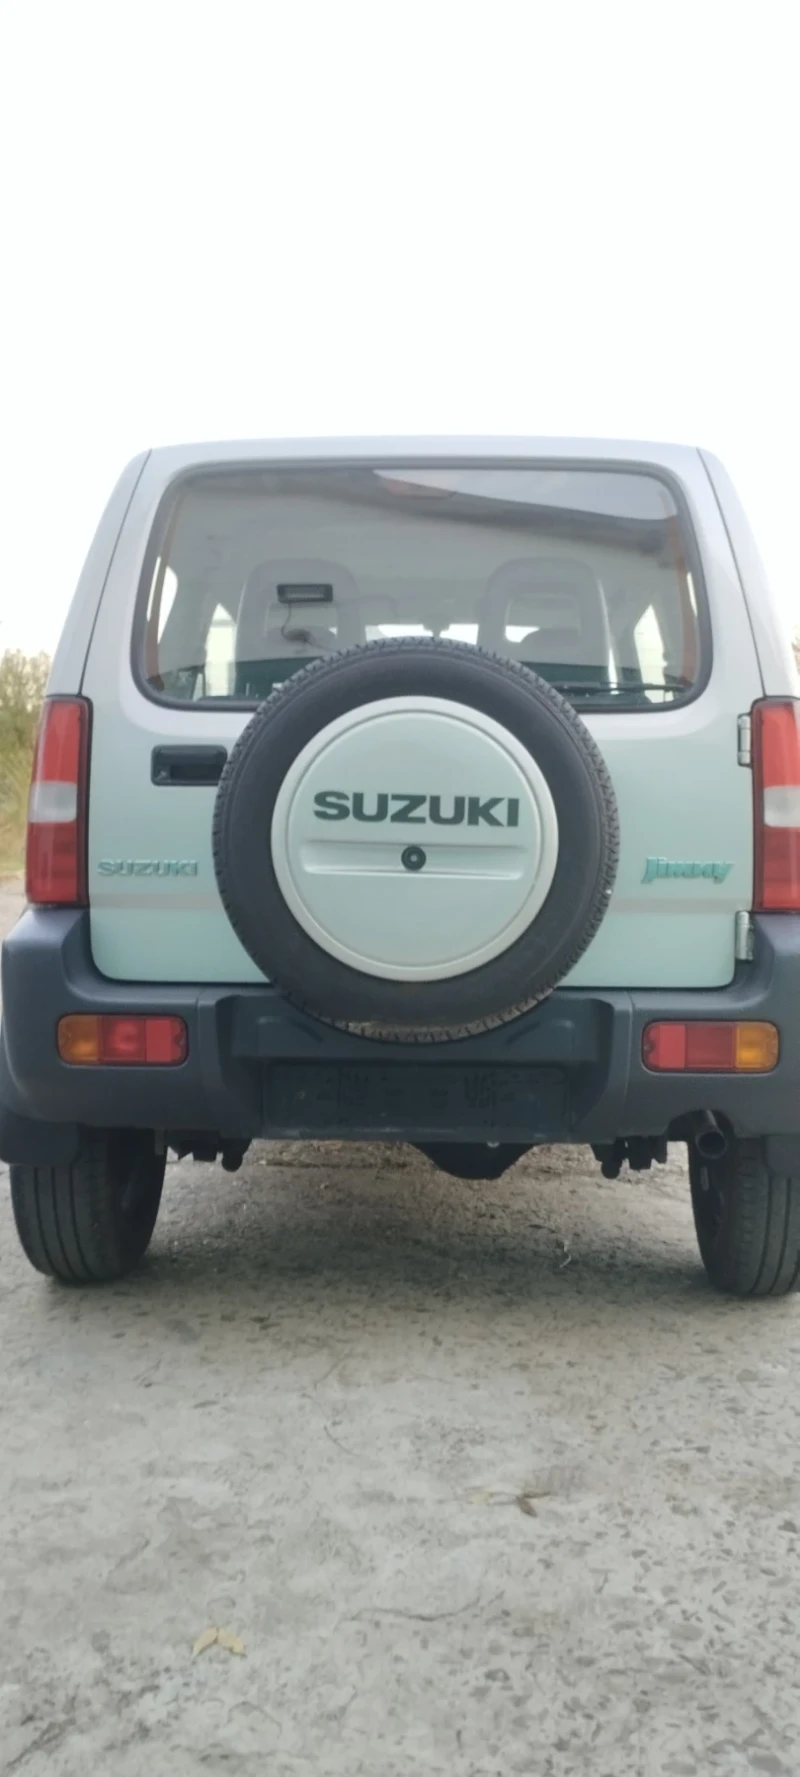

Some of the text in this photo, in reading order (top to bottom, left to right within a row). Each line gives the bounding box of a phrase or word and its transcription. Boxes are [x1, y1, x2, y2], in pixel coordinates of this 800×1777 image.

[313, 790, 520, 828] SUZUKI
[97, 859, 199, 877] SUZUKI
[640, 856, 735, 885] Jimny
